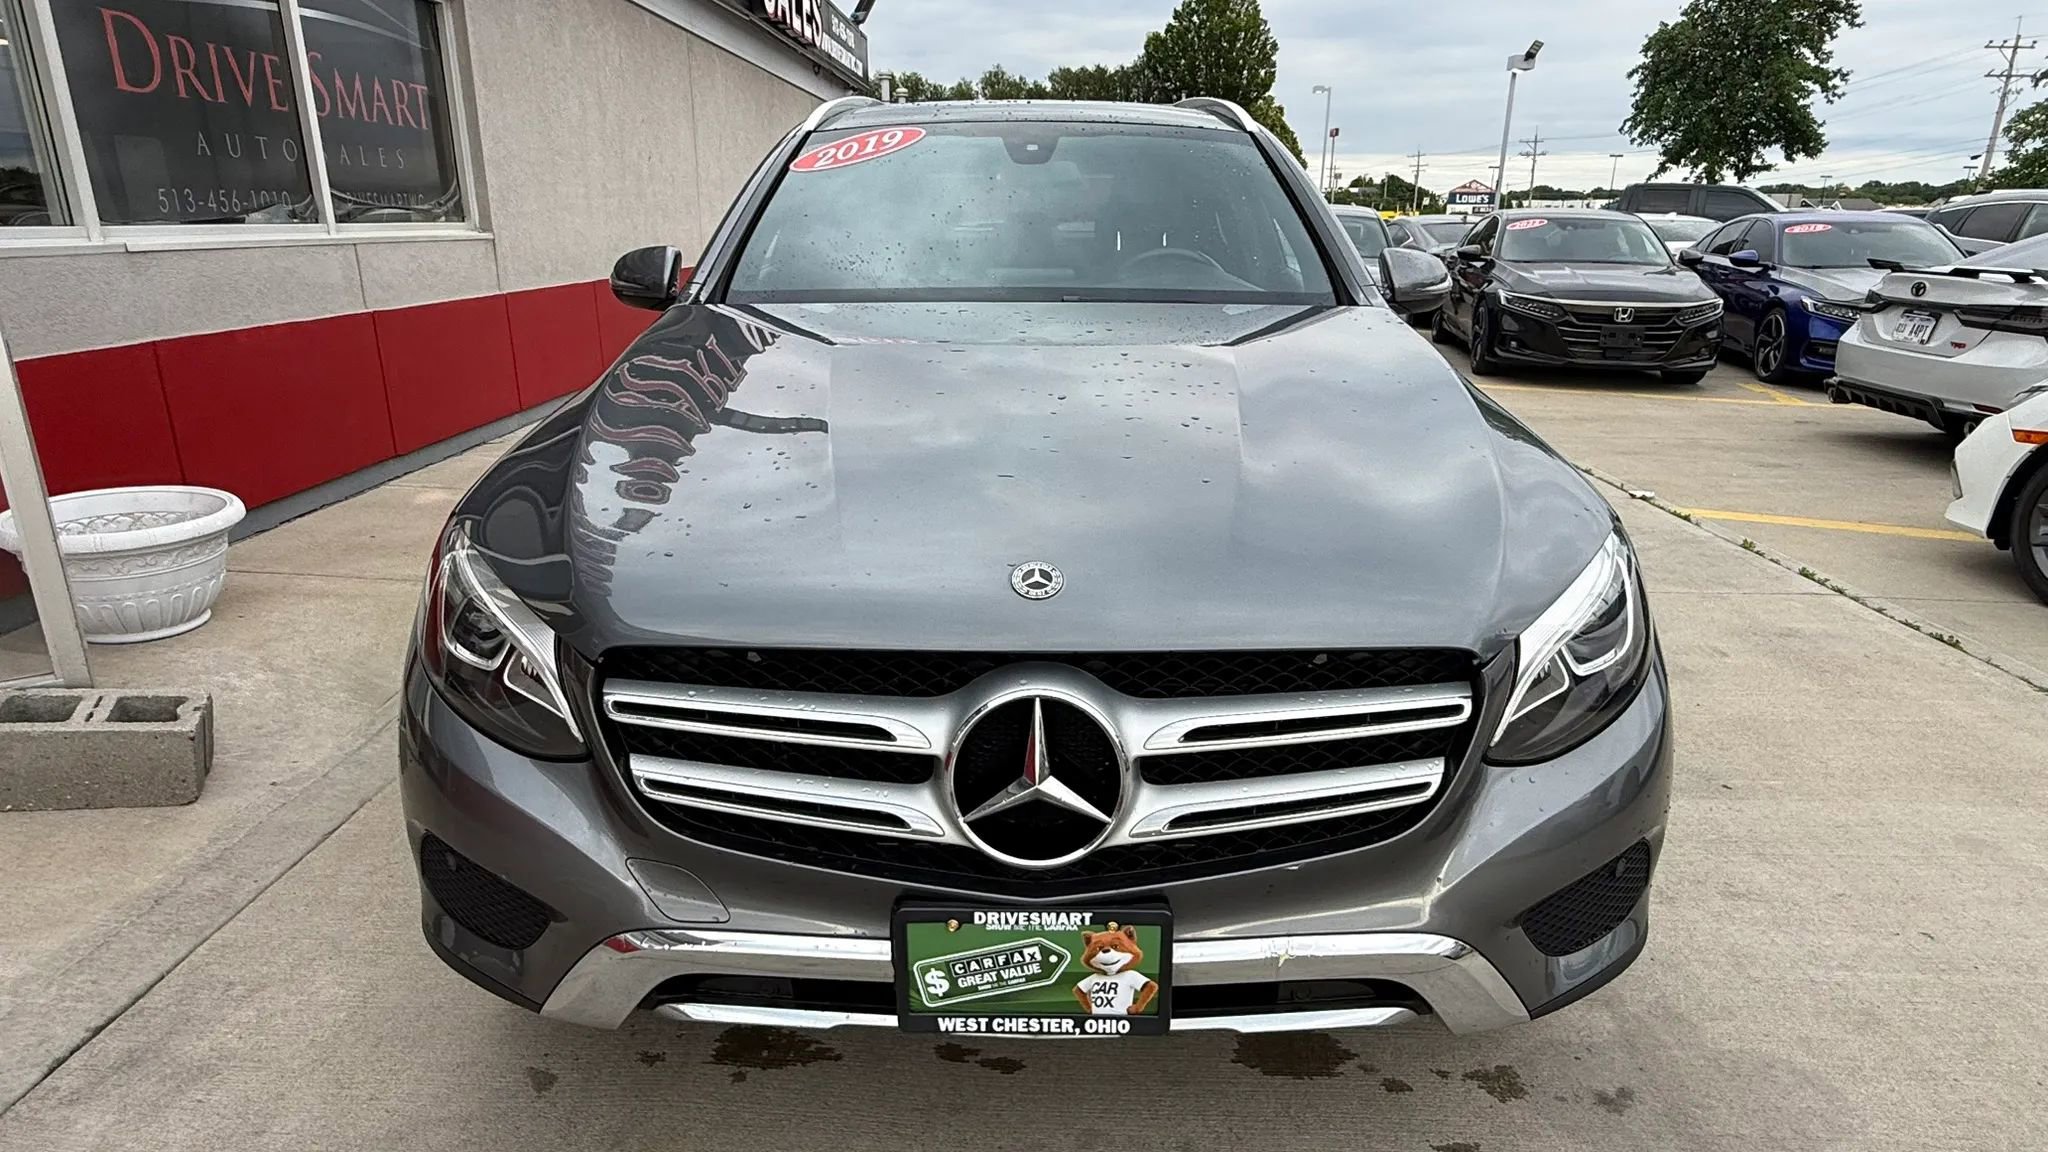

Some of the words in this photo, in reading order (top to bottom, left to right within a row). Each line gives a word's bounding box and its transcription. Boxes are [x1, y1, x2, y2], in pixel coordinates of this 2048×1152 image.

[197, 131, 298, 162] AUTO
[324, 141, 405, 169] ALES
[813, 130, 904, 168] 2019
[1455, 193, 1490, 203] LOWE'S
[973, 911, 1093, 925] DRIVESMART
[952, 948, 1041, 976] CARFAX
[957, 971, 998, 988] GREAT
[1000, 962, 1042, 980] VALUE
[1092, 981, 1119, 995] CAR
[937, 1017, 988, 1032] WEST
[992, 1017, 1081, 1036] CHESTER,
[1084, 1019, 1131, 1034] OHIO
